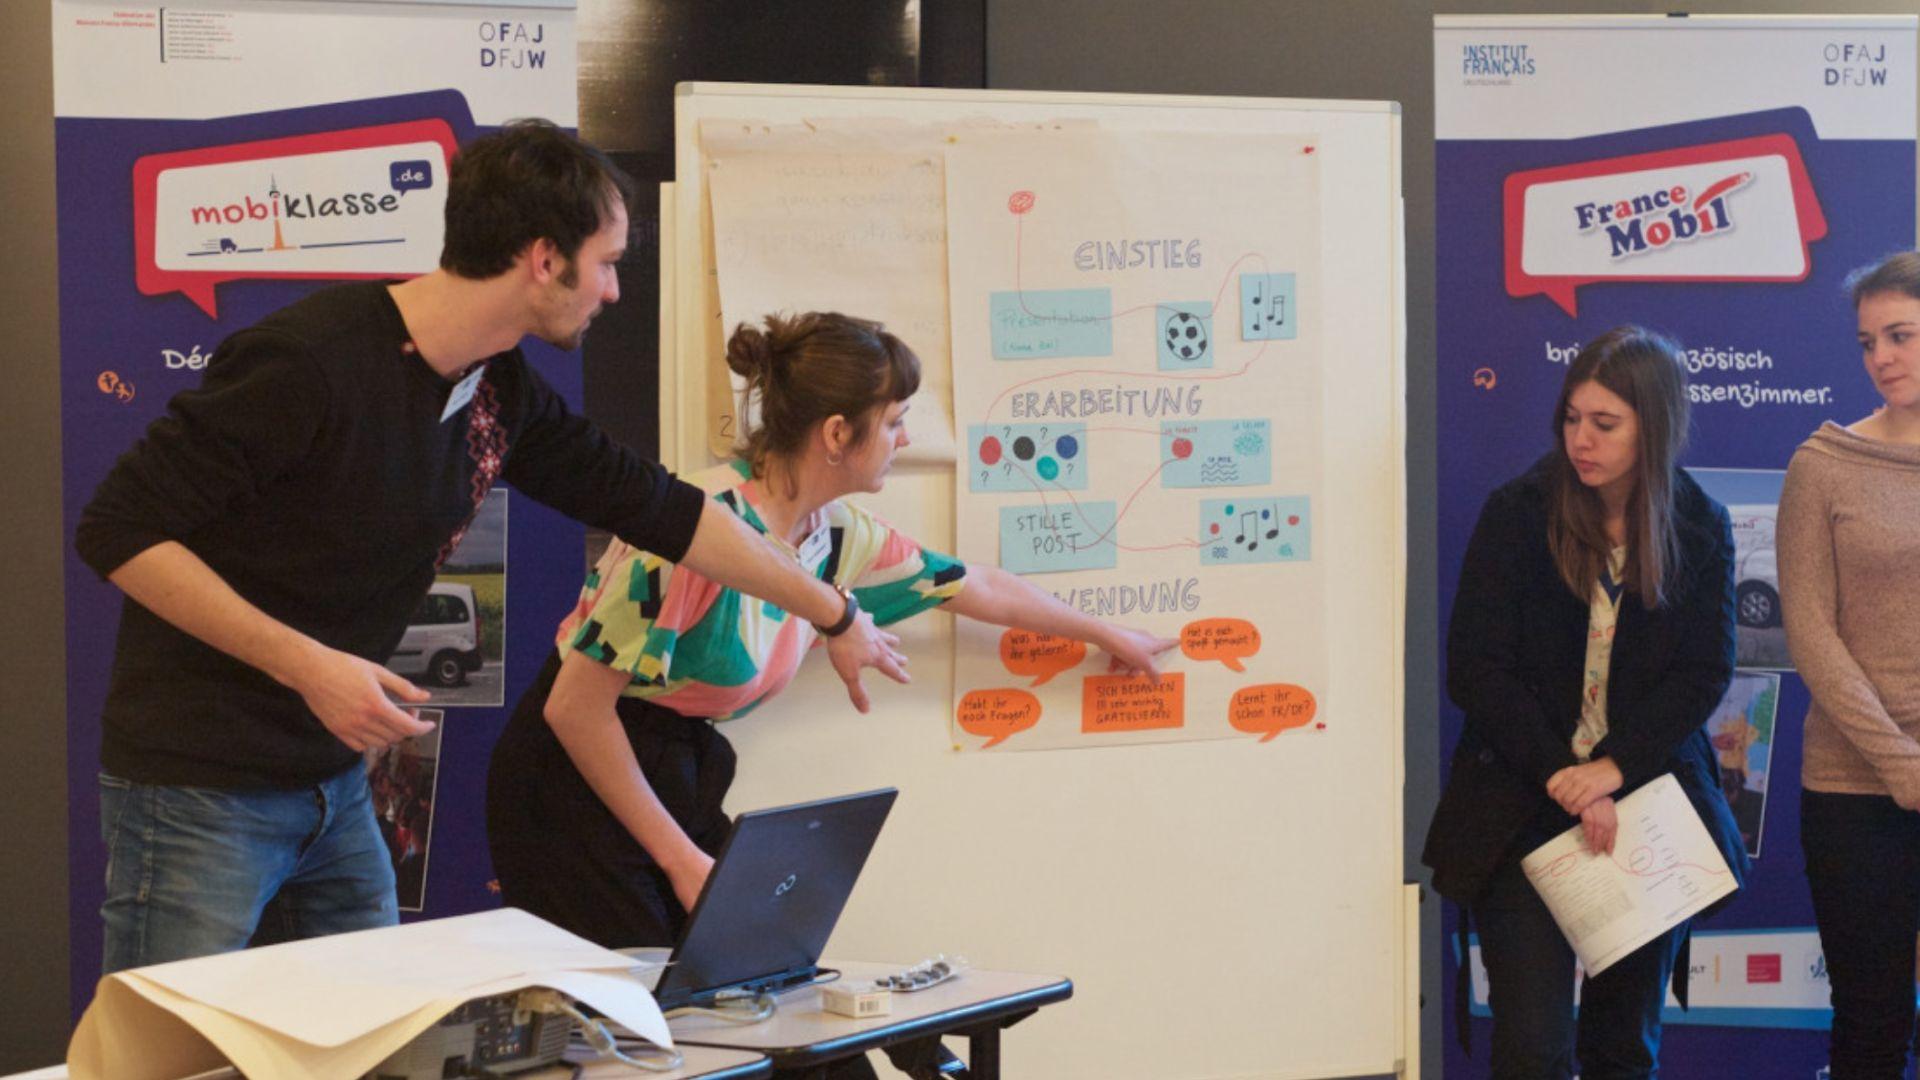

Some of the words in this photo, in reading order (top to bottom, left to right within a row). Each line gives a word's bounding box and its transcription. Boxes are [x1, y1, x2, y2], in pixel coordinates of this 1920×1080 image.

[479, 21, 543, 43] OFAJ
[480, 47, 545, 69] DFJW
[1463, 44, 1528, 61] INSTITUT
[1824, 43, 1884, 62] OFAJ
[1824, 67, 1886, 86] DFJW
[191, 193, 399, 225] mobiklasse
[1574, 185, 1687, 229] France
[1605, 197, 1730, 258] Mobil
[1074, 238, 1201, 271] EINSTIEG
[1011, 385, 1203, 418] ERARBEITUNG
[1017, 511, 1073, 532] STILLE
[1032, 532, 1083, 555] POST
